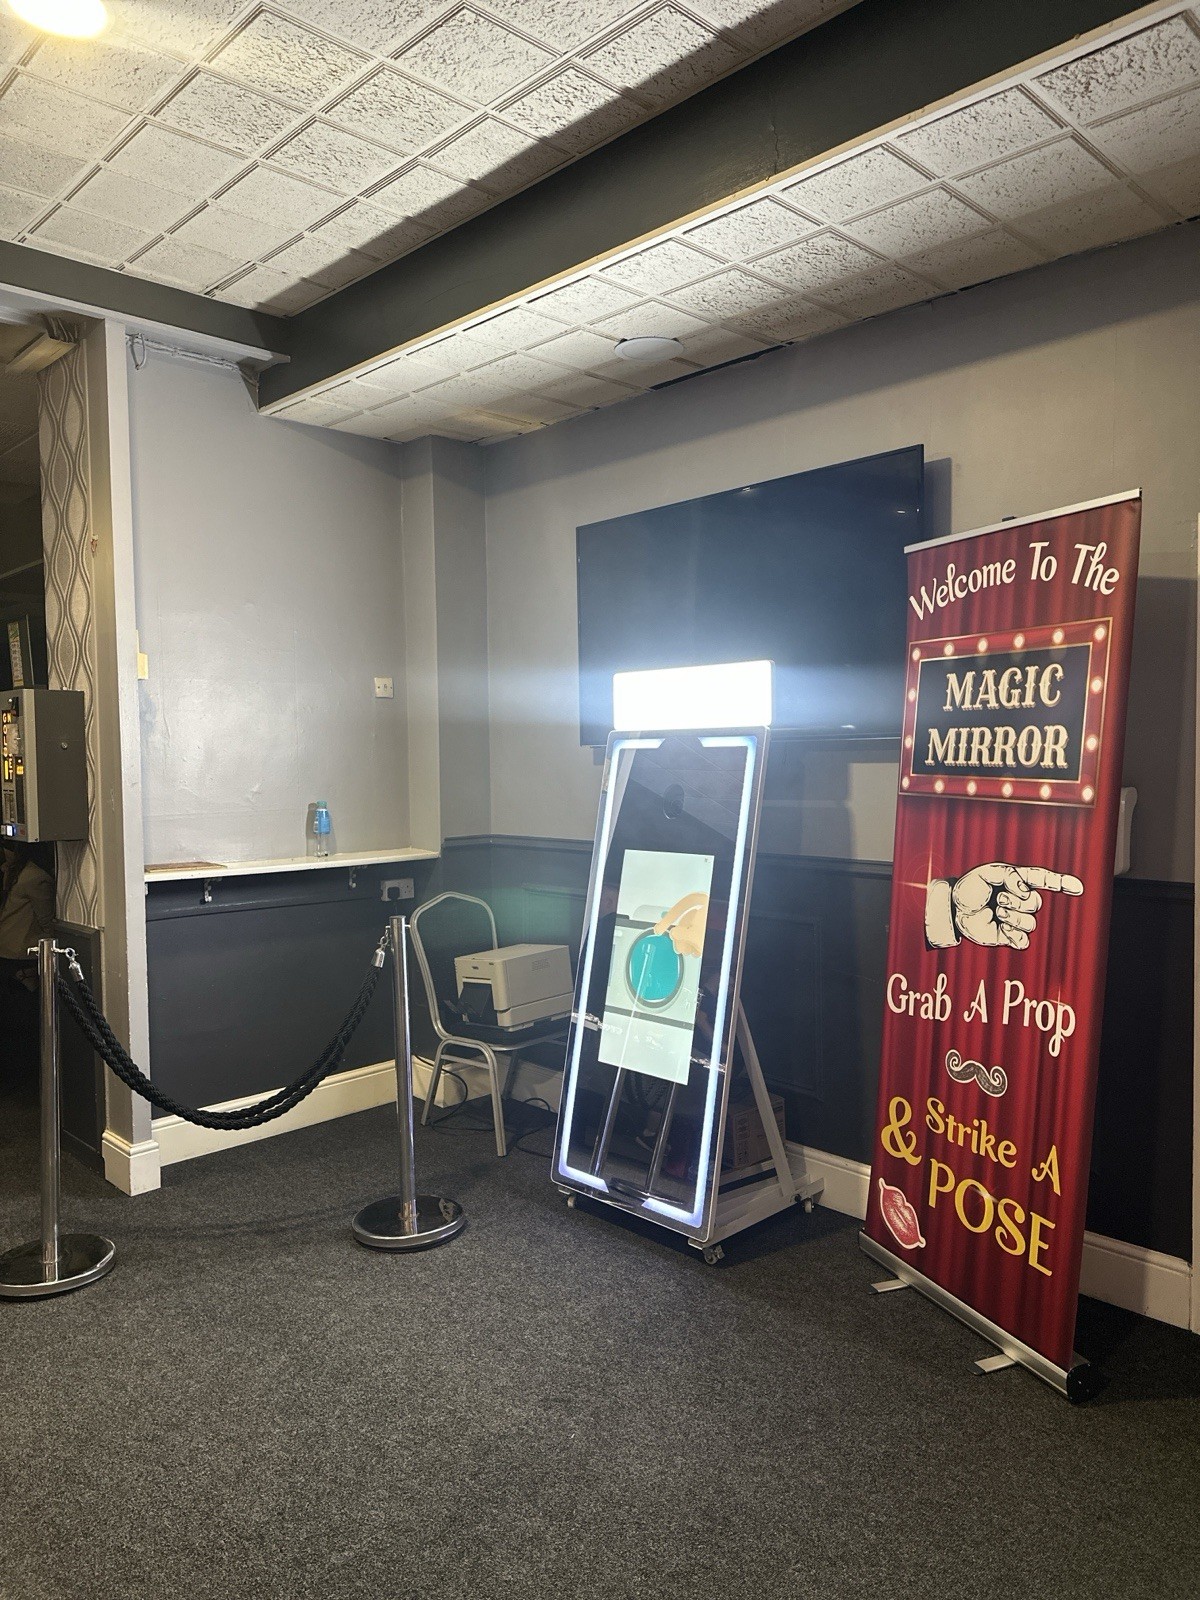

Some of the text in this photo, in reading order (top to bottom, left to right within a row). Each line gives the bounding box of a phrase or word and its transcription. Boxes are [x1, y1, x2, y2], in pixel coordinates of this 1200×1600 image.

[909, 541, 1119, 620] Welcome To The
[943, 663, 1064, 711] MAGIC
[925, 724, 1069, 769] MIRROR
[886, 973, 1076, 1057] Grab A Prop
[881, 1096, 1061, 1196] & Strike A
[928, 1158, 1056, 1276] POSE
